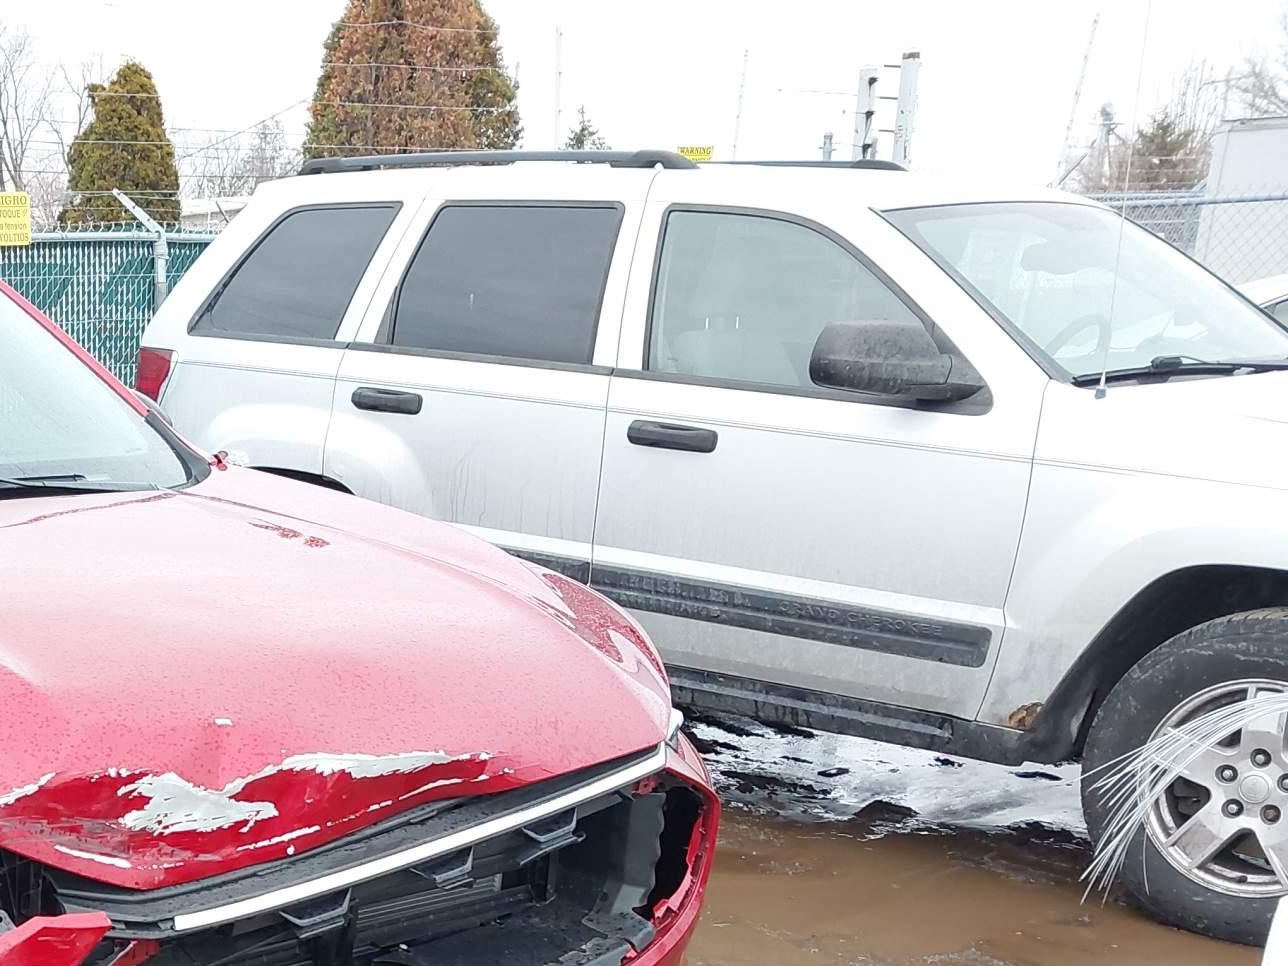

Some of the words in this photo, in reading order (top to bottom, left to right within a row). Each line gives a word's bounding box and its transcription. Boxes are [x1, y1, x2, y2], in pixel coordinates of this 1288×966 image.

[0, 209, 21, 218] TOQUE
[778, 600, 840, 620] GRAND
[847, 612, 943, 636] CHEROKEE
